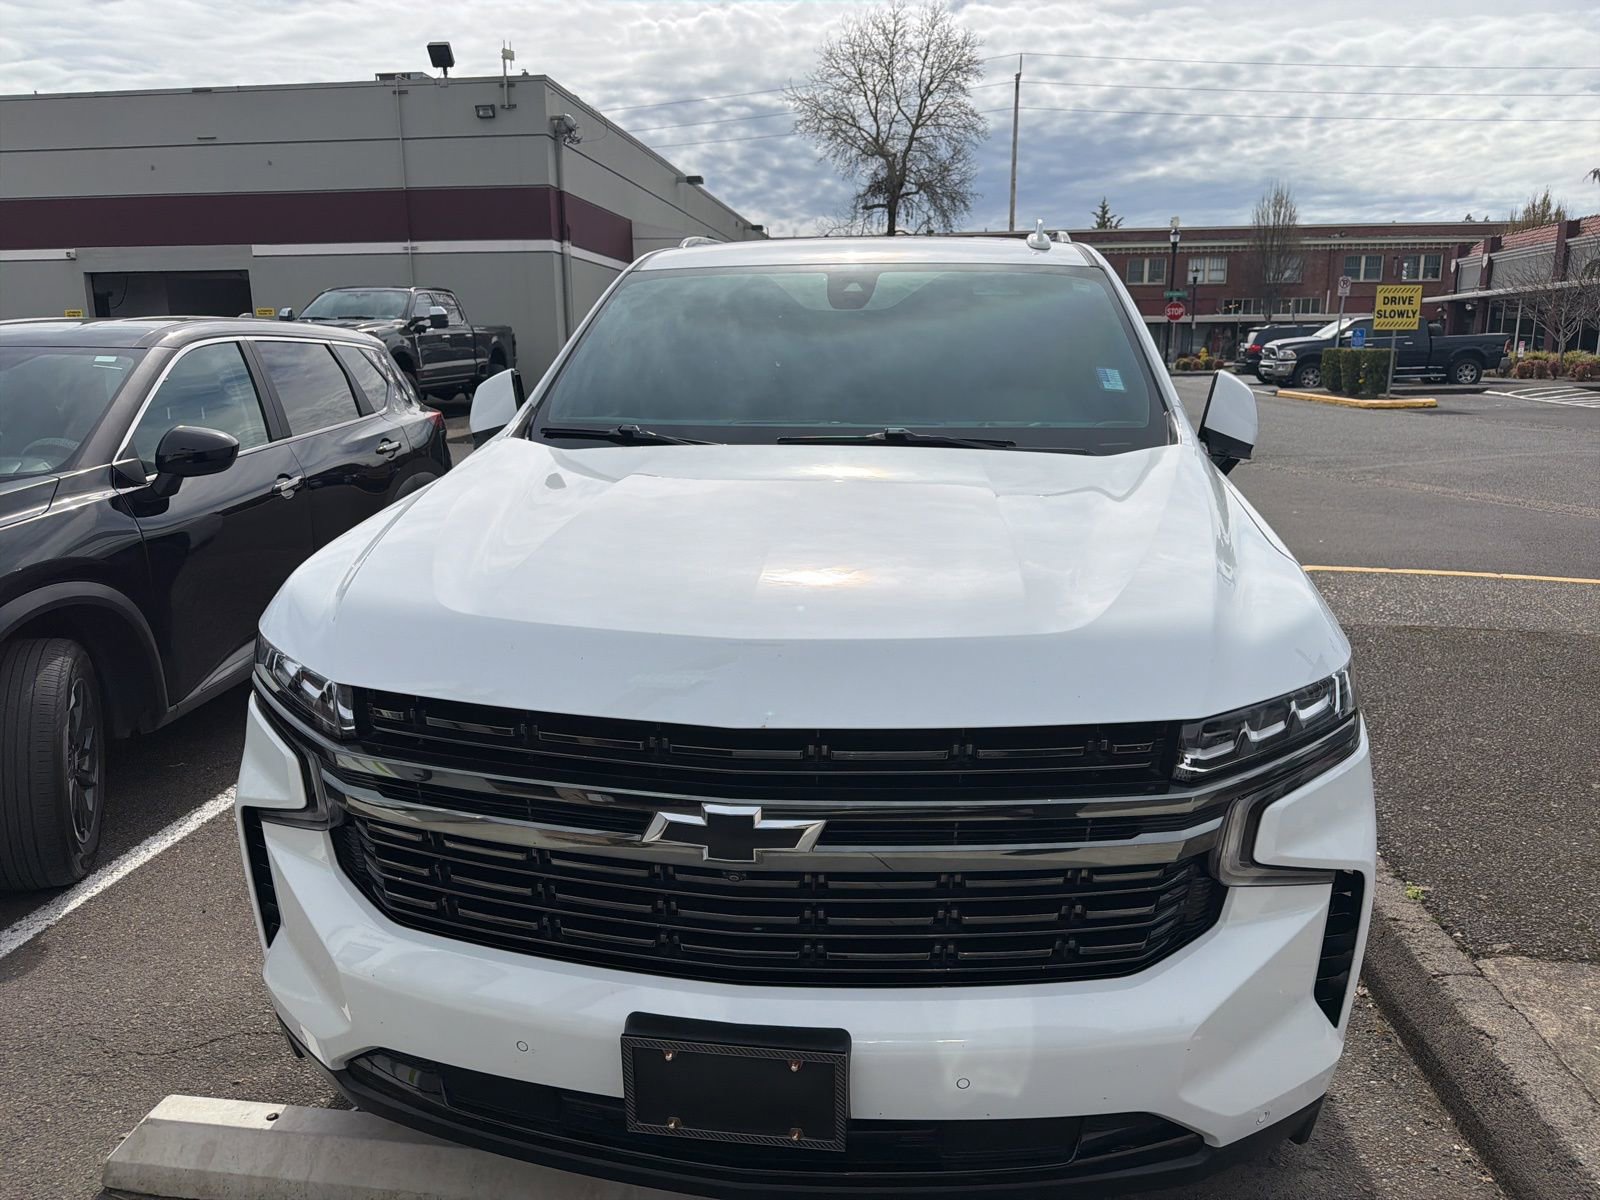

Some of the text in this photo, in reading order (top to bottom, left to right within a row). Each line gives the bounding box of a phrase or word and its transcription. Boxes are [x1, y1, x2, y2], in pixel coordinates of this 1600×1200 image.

[1383, 296, 1414, 305] DRIVE
[1167, 307, 1184, 316] STOP
[1376, 309, 1418, 319] SLOWLY
